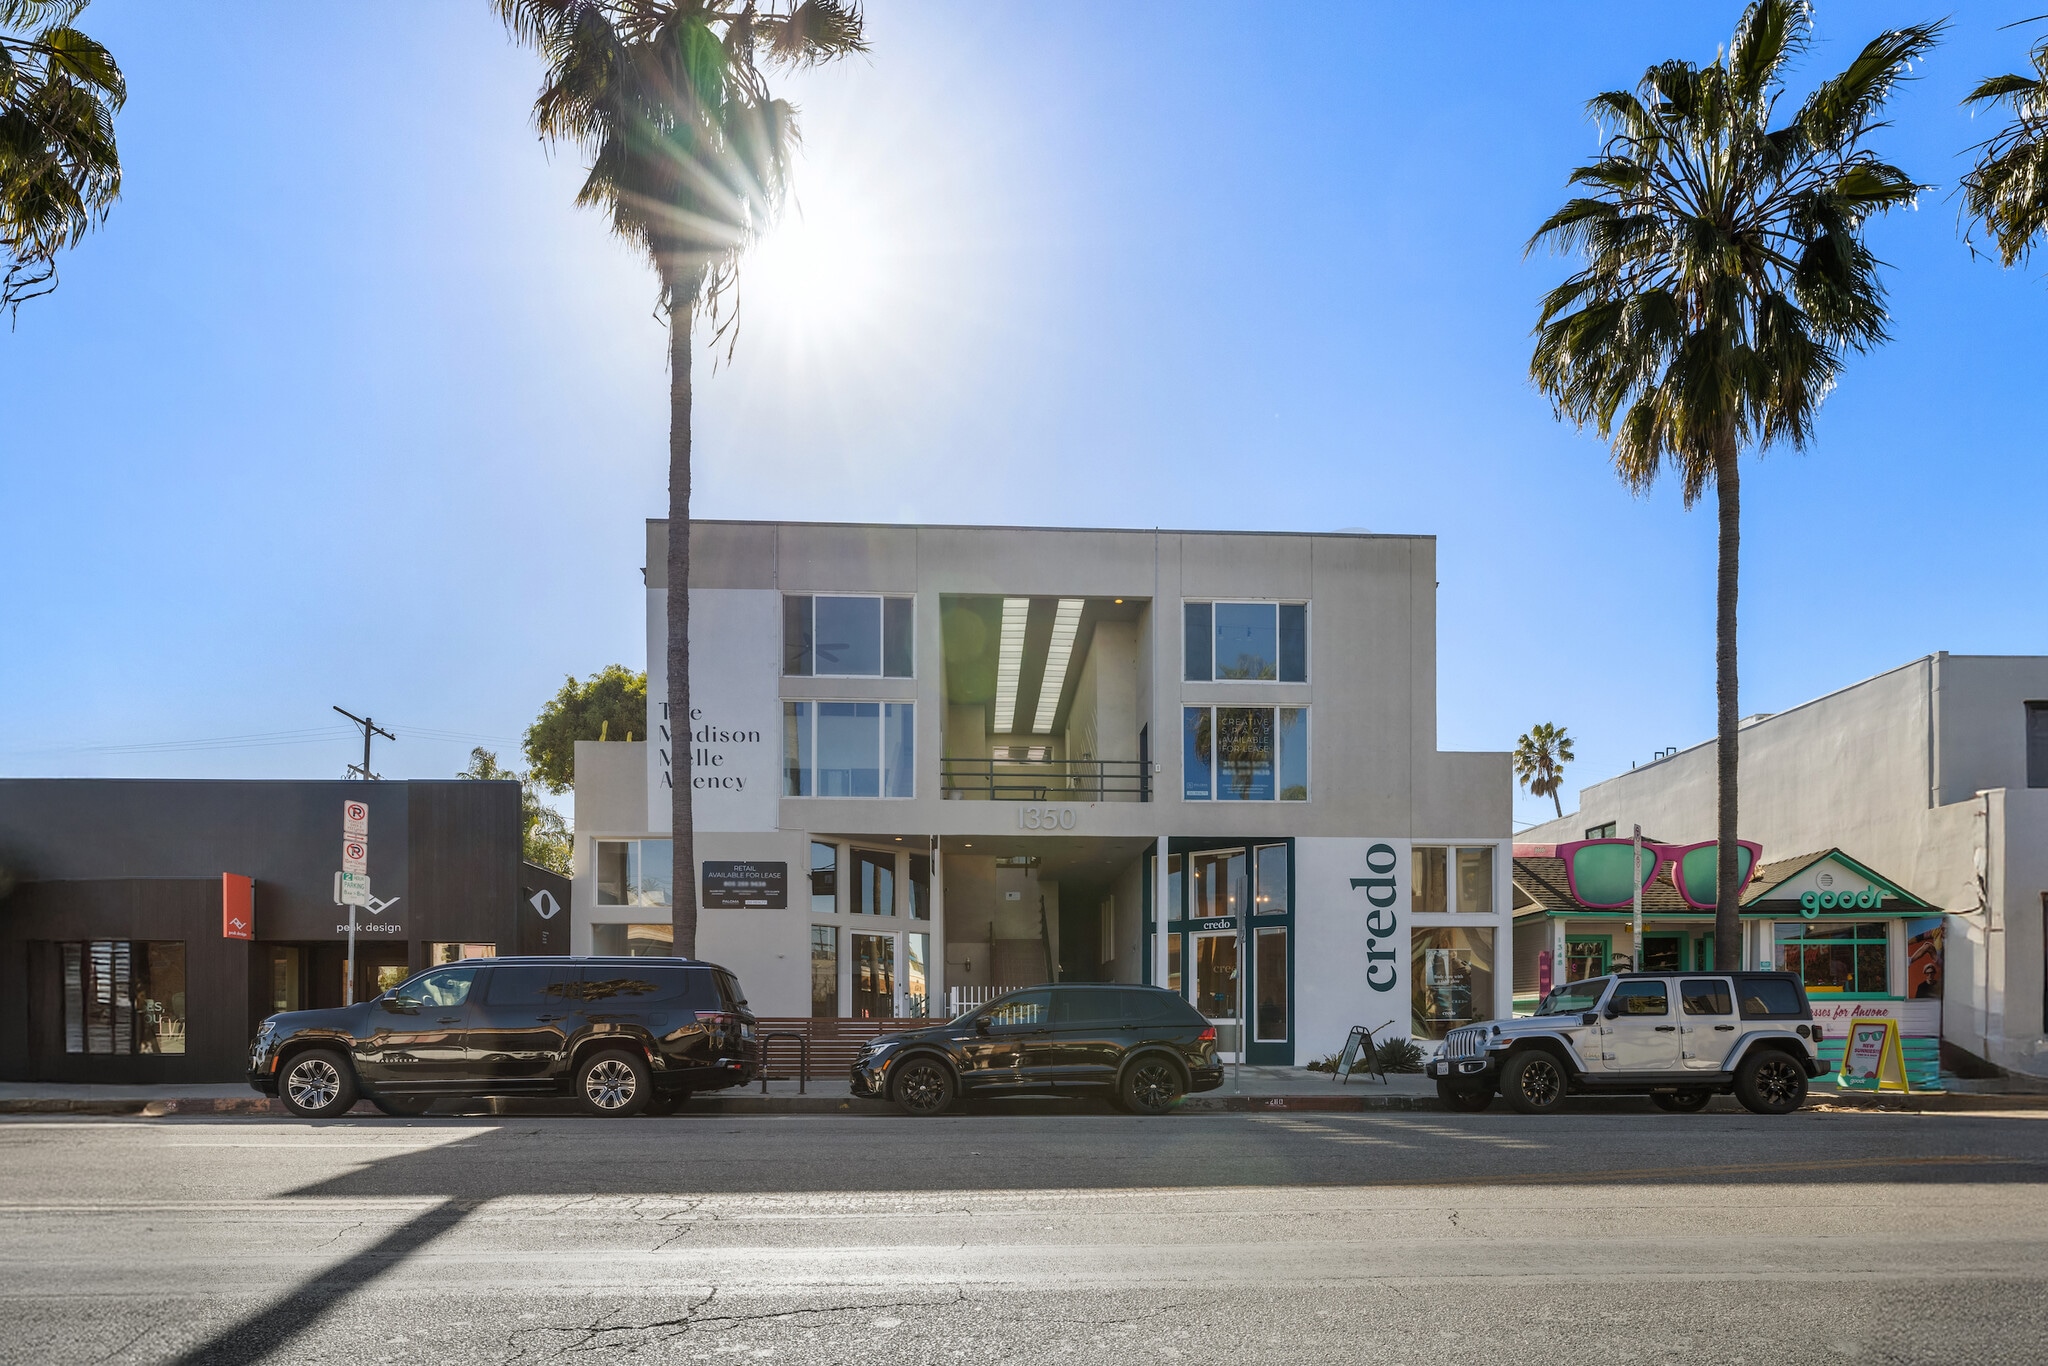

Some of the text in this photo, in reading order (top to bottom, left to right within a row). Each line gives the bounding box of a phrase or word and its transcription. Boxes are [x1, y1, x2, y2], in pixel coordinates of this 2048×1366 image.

[658, 702, 702, 720] Te
[1221, 718, 1269, 726] CREATIVE
[660, 724, 760, 743] Mdison
[1221, 736, 1269, 744] AVAILABLE
[660, 748, 724, 767] Mlle
[1221, 745, 1269, 753] FOR LEASE
[660, 771, 747, 792] Aency
[1018, 807, 1077, 831] 1350
[344, 881, 365, 890] PARKING
[1801, 885, 1892, 919] goodr
[1203, 919, 1231, 930] credo
[1350, 843, 1397, 992] credo
[336, 922, 402, 934] pek design
[1833, 1004, 1849, 1020] for
[1851, 1004, 1889, 1017] Anyone
